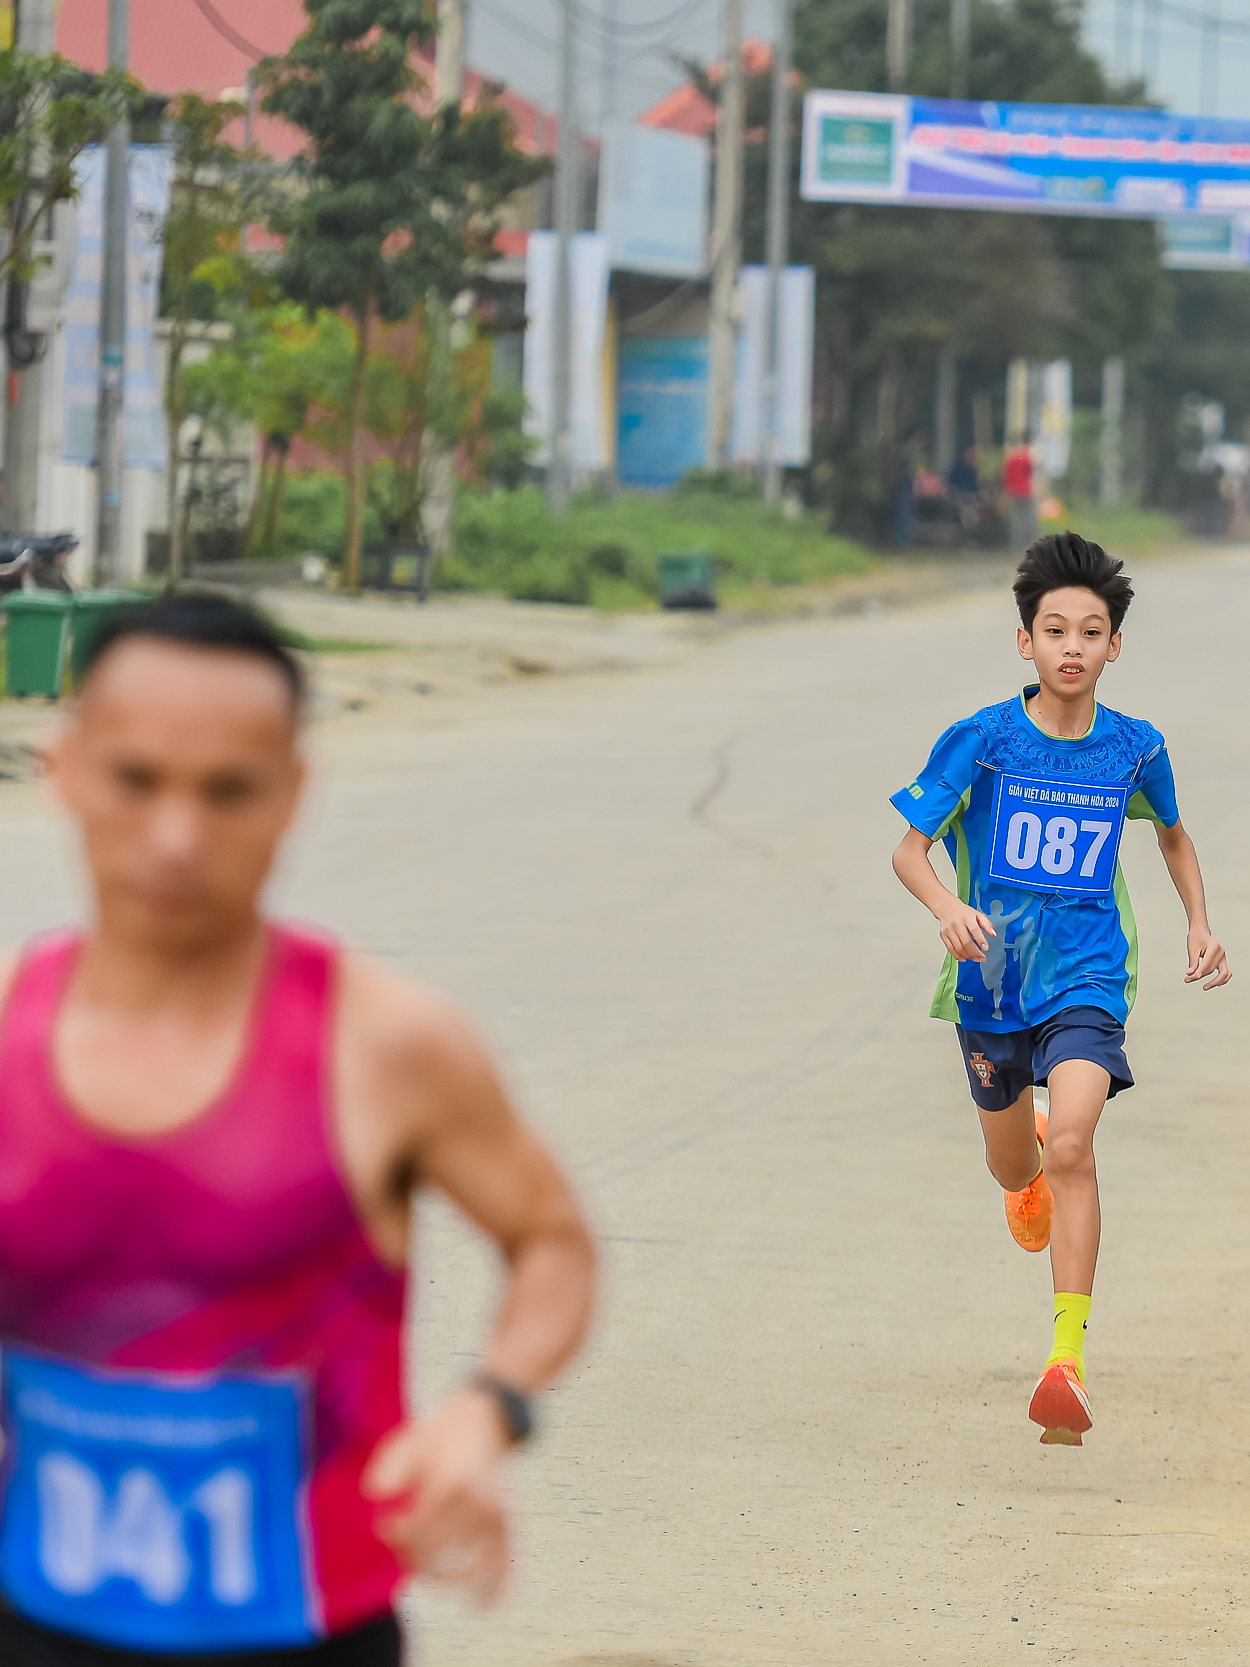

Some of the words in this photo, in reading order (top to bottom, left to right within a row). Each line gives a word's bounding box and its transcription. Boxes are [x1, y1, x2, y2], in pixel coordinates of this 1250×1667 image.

[1008, 783, 1023, 798] GIẢI
[1023, 787, 1039, 802] VIỆT
[1067, 793, 1090, 806] THANH
[1090, 794, 1104, 807] HÓA
[1105, 796, 1119, 808] 2024
[1005, 811, 1112, 877] 087
